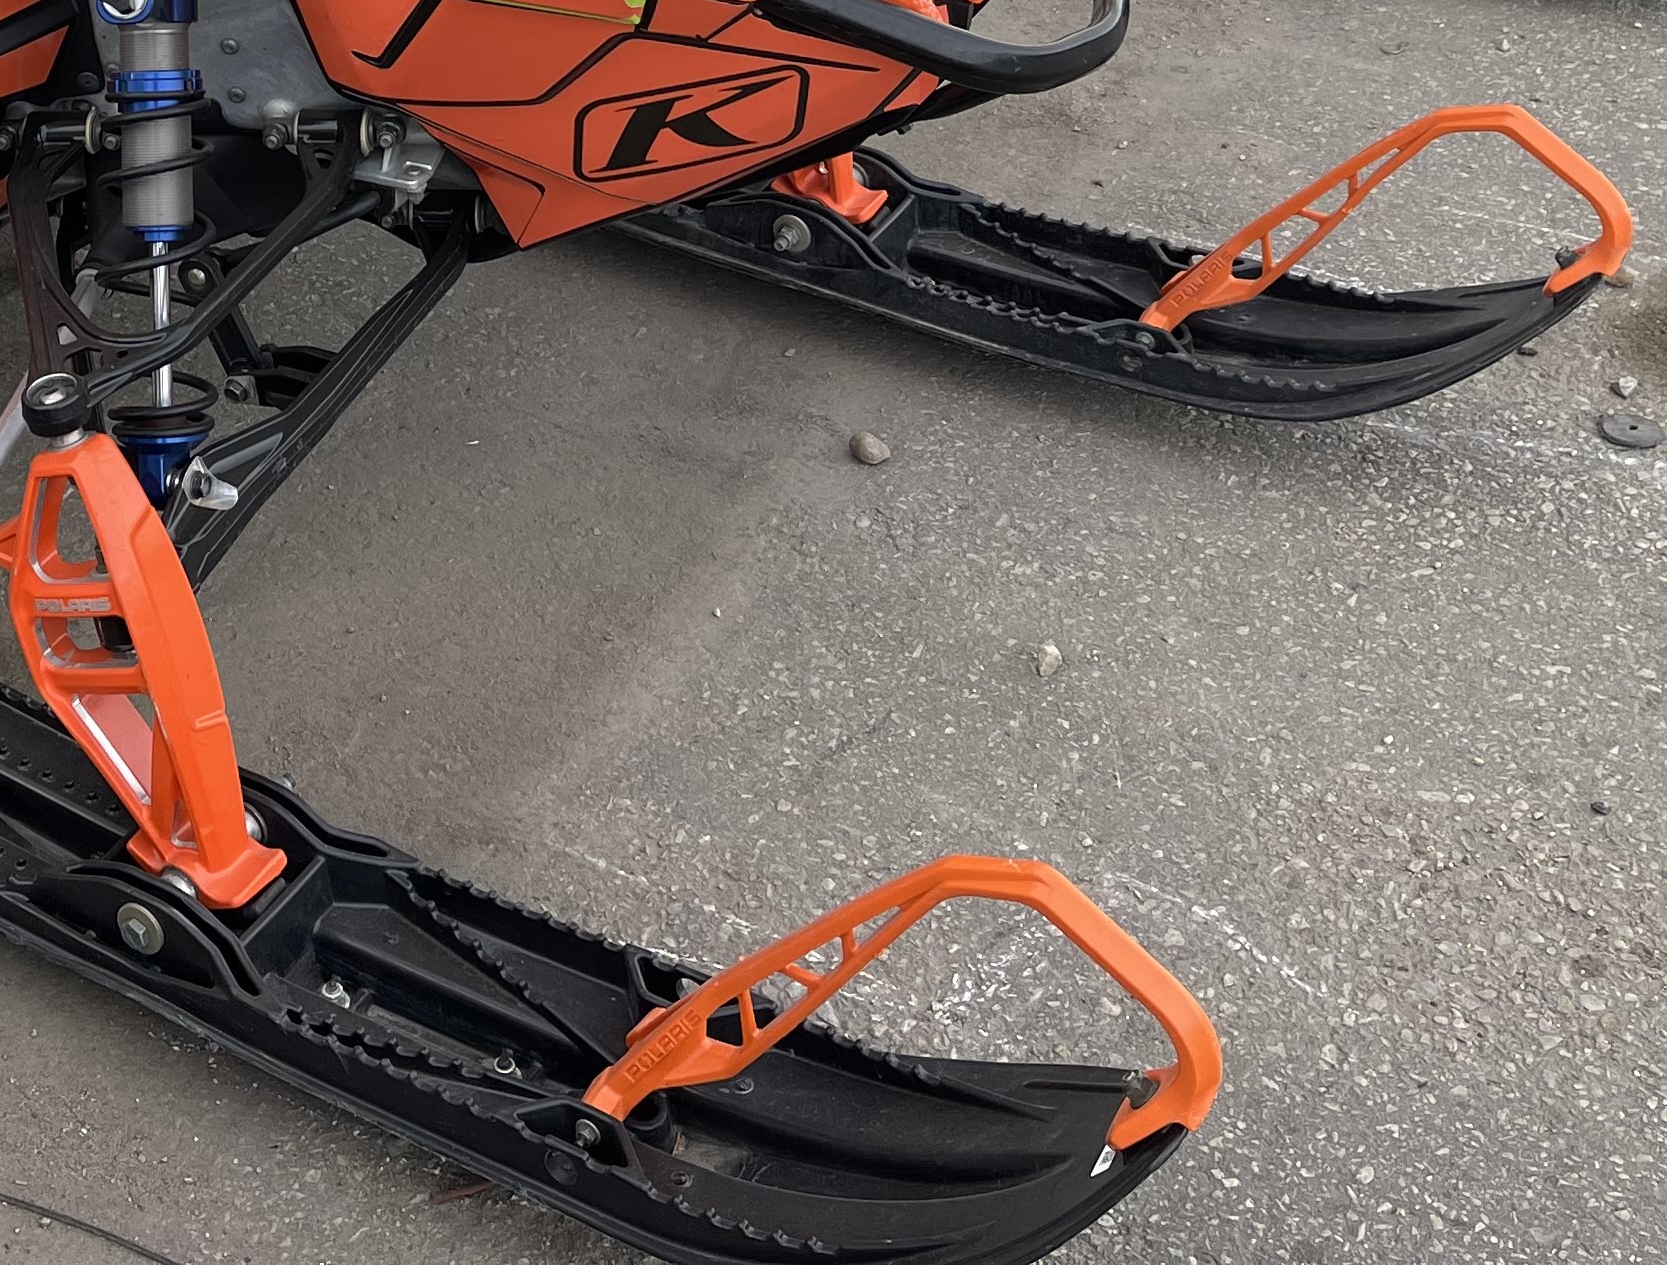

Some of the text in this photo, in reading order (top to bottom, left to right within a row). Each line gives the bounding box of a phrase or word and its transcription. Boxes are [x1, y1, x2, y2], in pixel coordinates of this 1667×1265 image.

[595, 74, 798, 172] K
[1170, 250, 1234, 308] POLARIS
[35, 597, 112, 613] POLARIS
[623, 1008, 702, 1084] POLARIS
